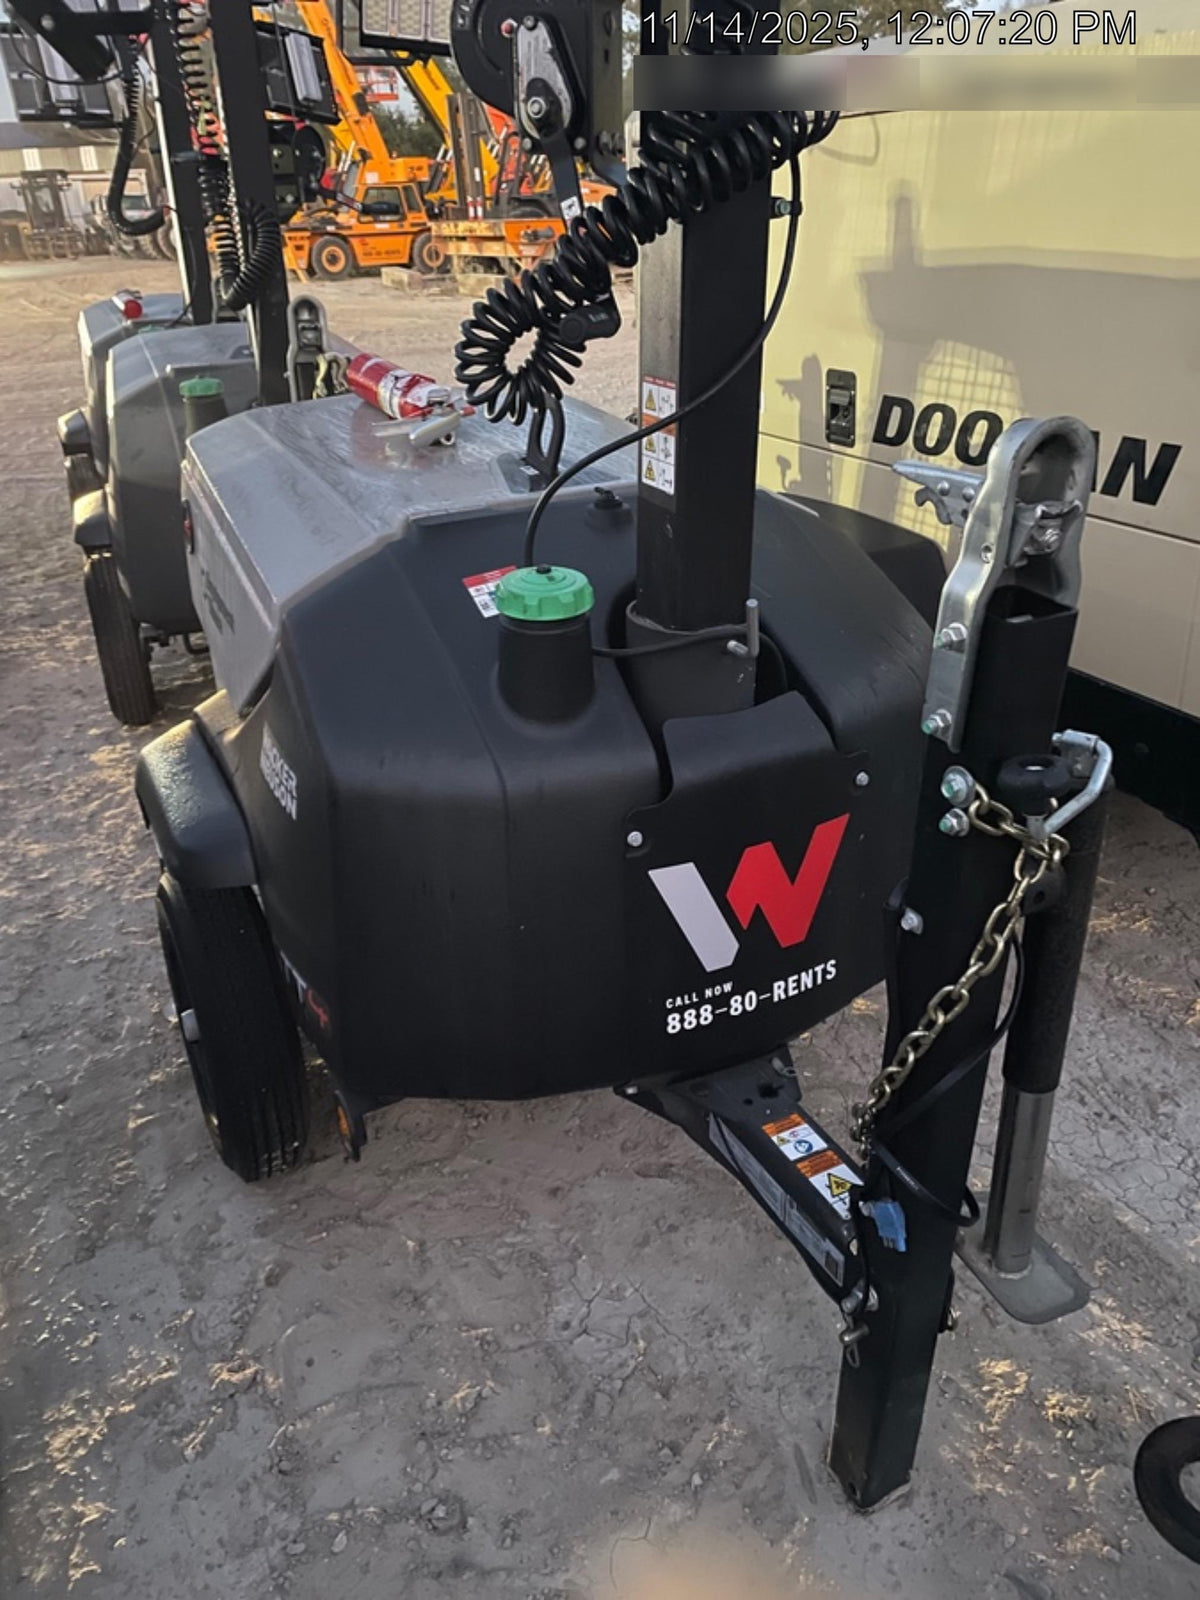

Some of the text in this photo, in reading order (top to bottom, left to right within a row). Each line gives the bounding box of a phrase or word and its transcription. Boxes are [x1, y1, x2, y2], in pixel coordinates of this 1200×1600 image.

[872, 394, 1183, 506] DOON
[665, 981, 734, 1009] CALL NOW
[665, 959, 838, 1035] 888-80-RENTS
